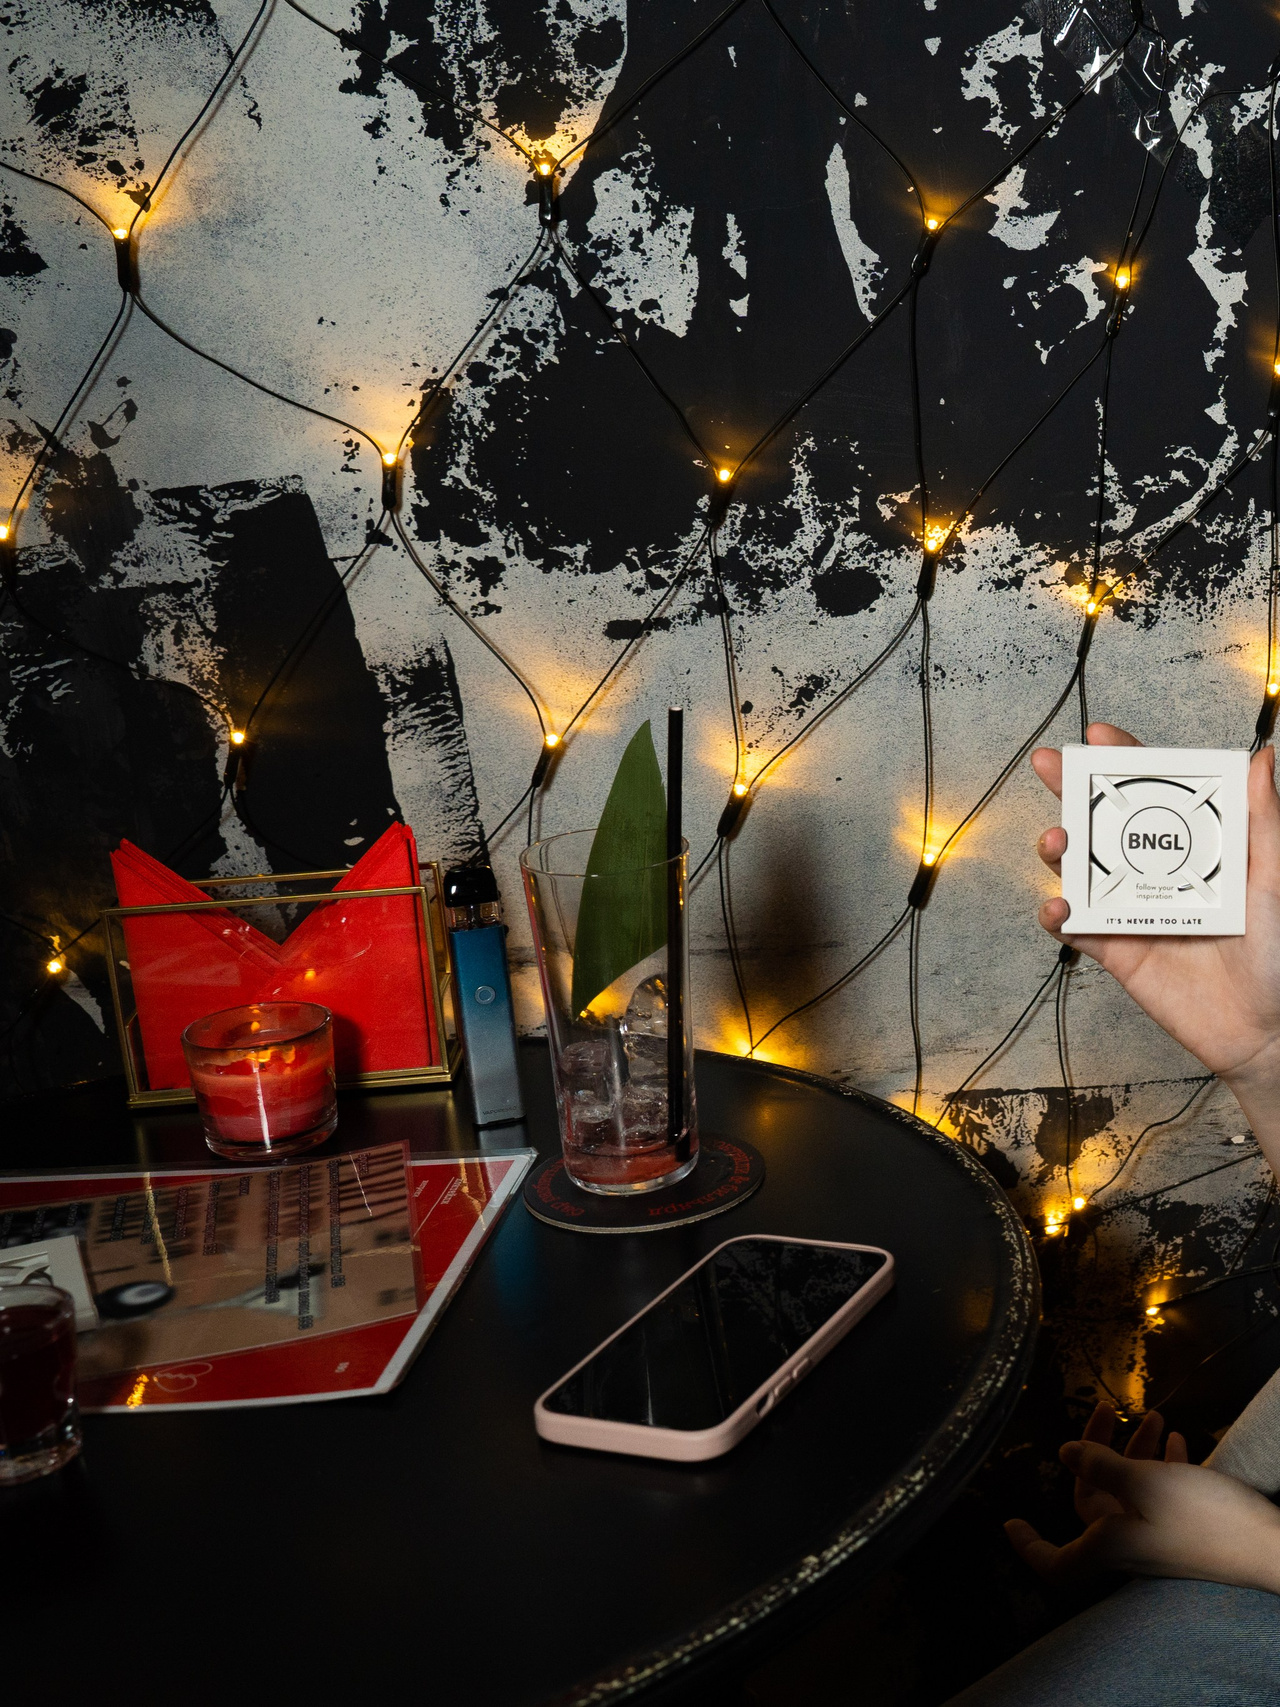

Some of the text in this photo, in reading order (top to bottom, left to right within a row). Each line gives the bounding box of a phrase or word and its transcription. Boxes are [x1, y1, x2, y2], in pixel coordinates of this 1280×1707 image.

[1128, 833, 1184, 850] BNGL
[1136, 883, 1174, 893] follow your
[1136, 892, 1173, 901] inspiration
